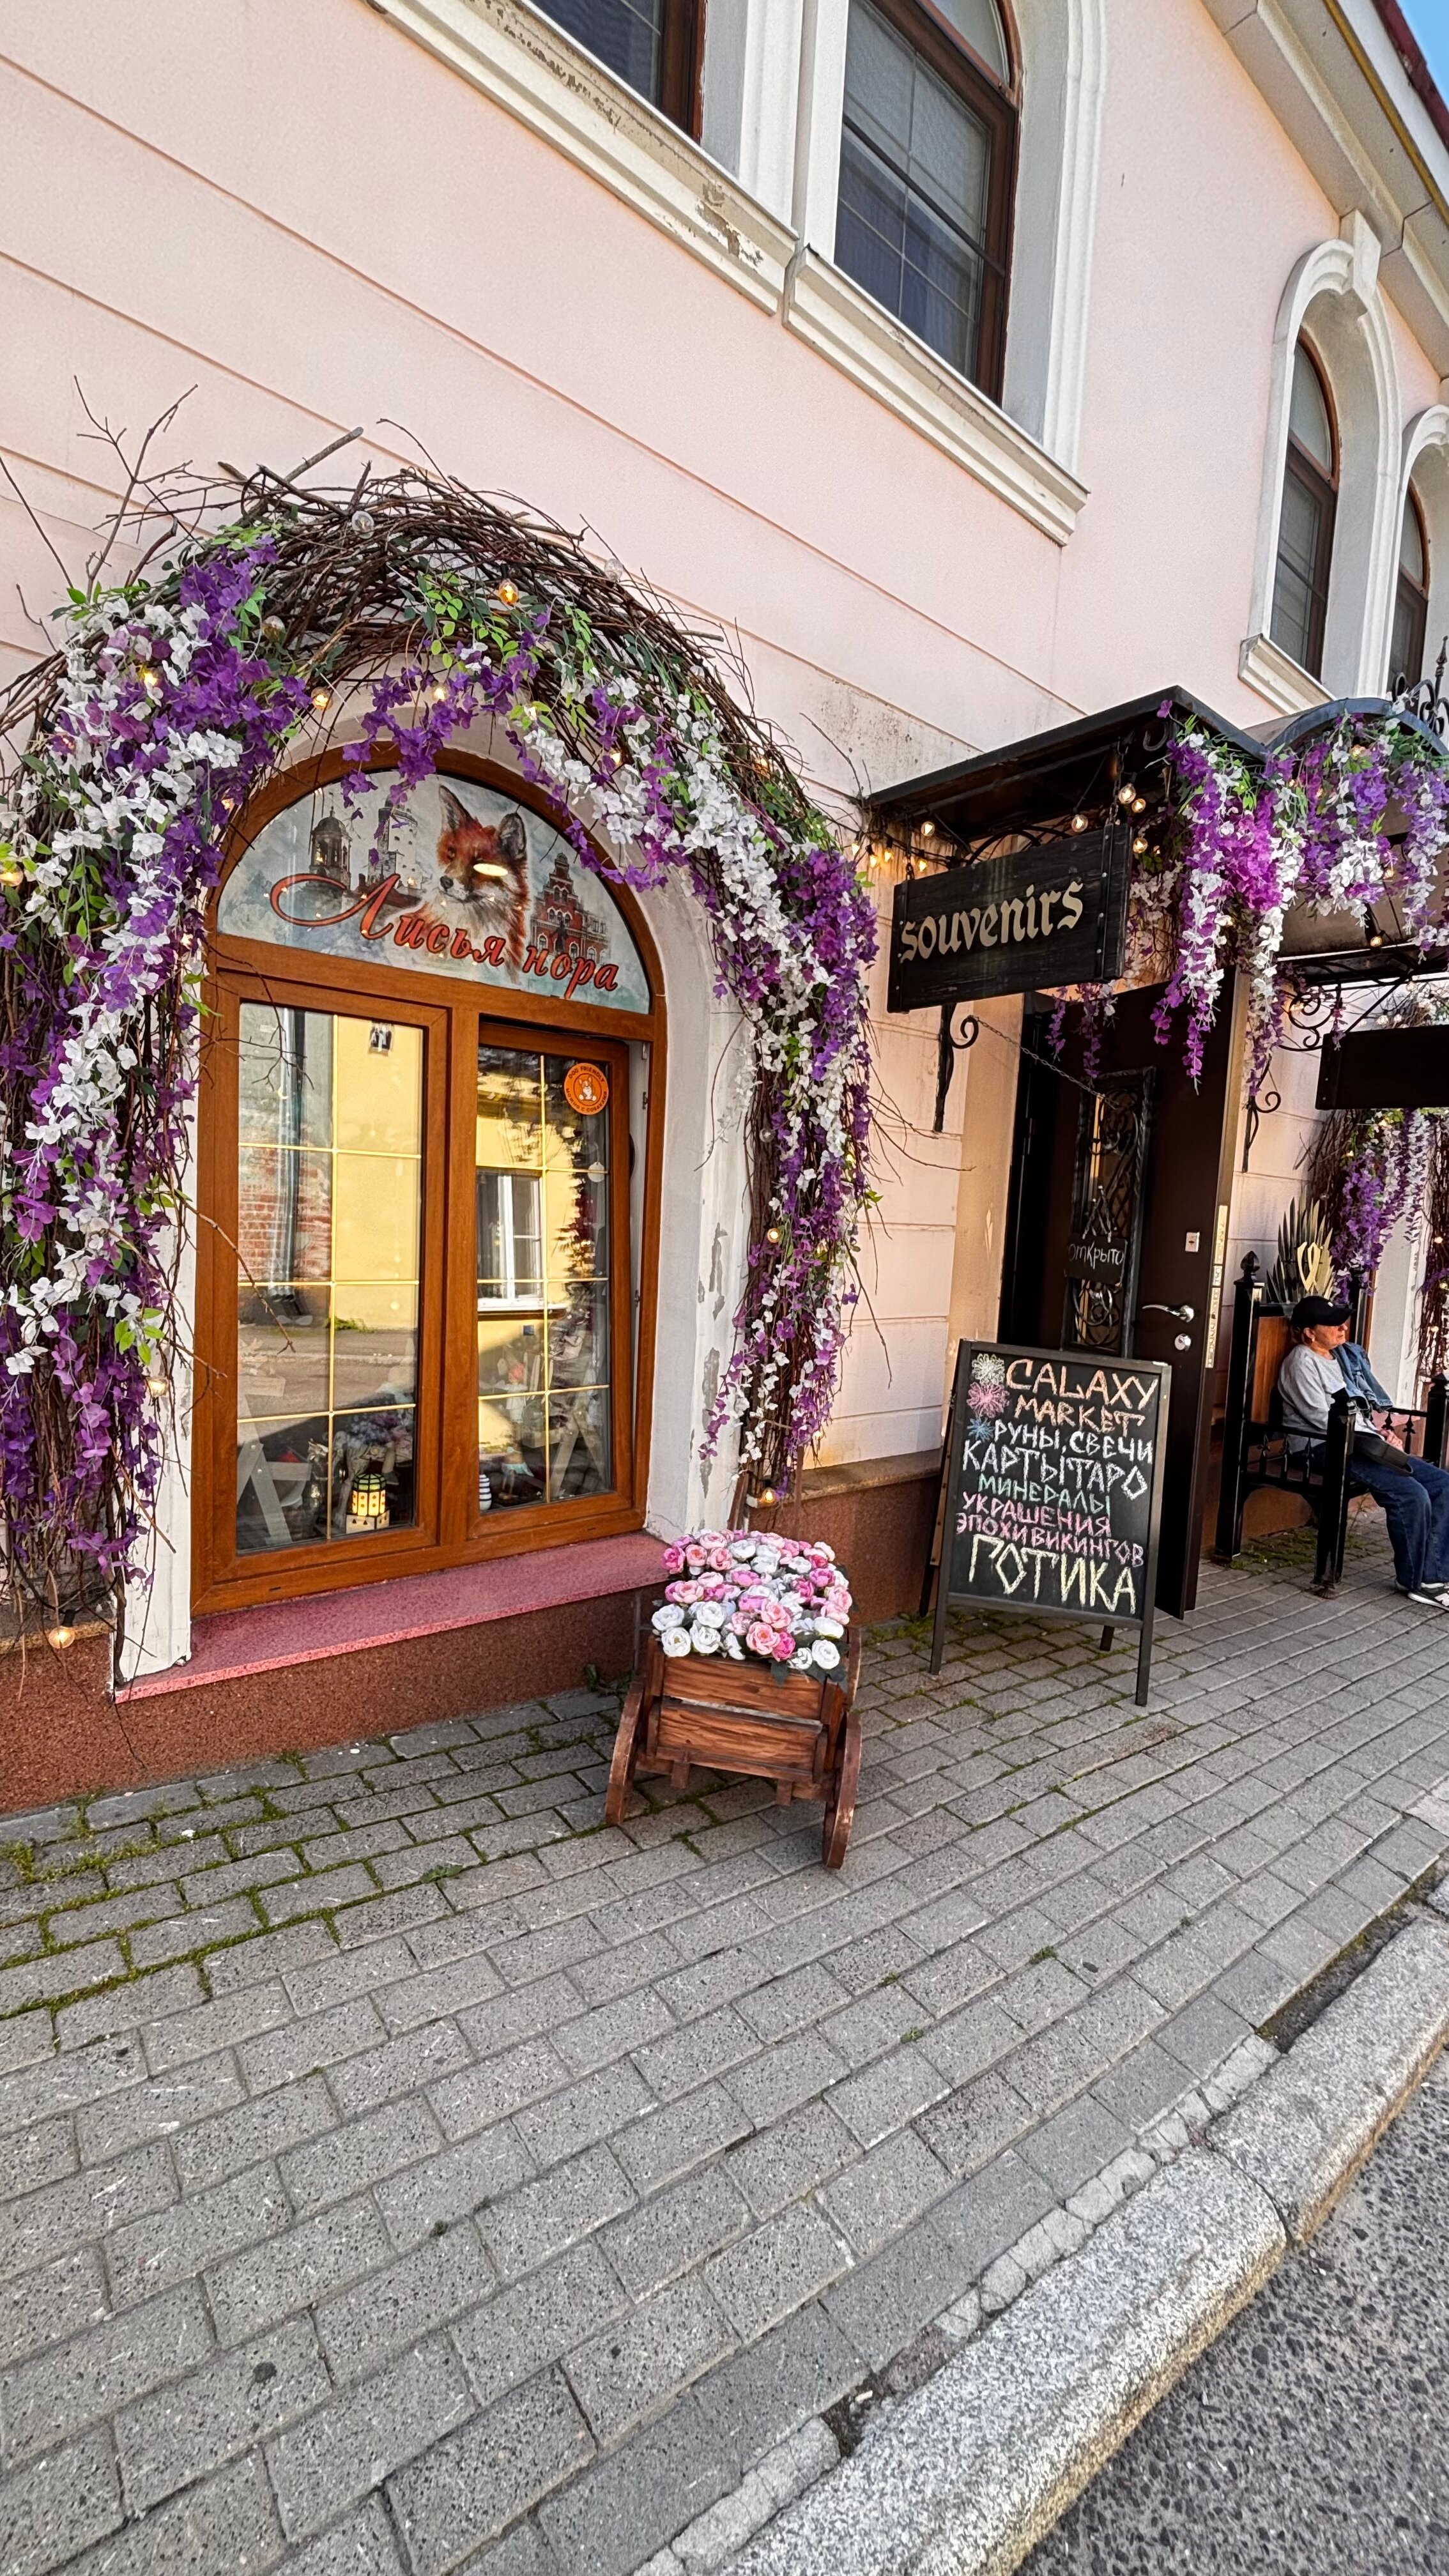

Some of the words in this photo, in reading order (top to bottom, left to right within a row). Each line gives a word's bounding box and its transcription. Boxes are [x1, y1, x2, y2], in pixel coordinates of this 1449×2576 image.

[270, 873, 506, 967] Лисья
[522, 945, 618, 999] нора
[900, 881, 1084, 963] souvenirs
[568, 1068, 579, 1079] DOG
[580, 1066, 605, 1082] FRIENDLY
[565, 1088, 580, 1109] МОЖНО
[586, 1091, 608, 1112] СОБАКАМИ
[1014, 1394, 1146, 1438] MARKET
[1070, 1431, 1153, 1464] СВЕЧИ
[963, 1491, 1112, 1538] УКРАШЕНИЯ
[978, 1473, 1110, 1518] МИНЕРАЛЫ
[956, 1512, 1029, 1546] ЭПОХИ
[1031, 1527, 1144, 1568] ВИКИНГОВ
[969, 1533, 1136, 1615] ГОТИКА
